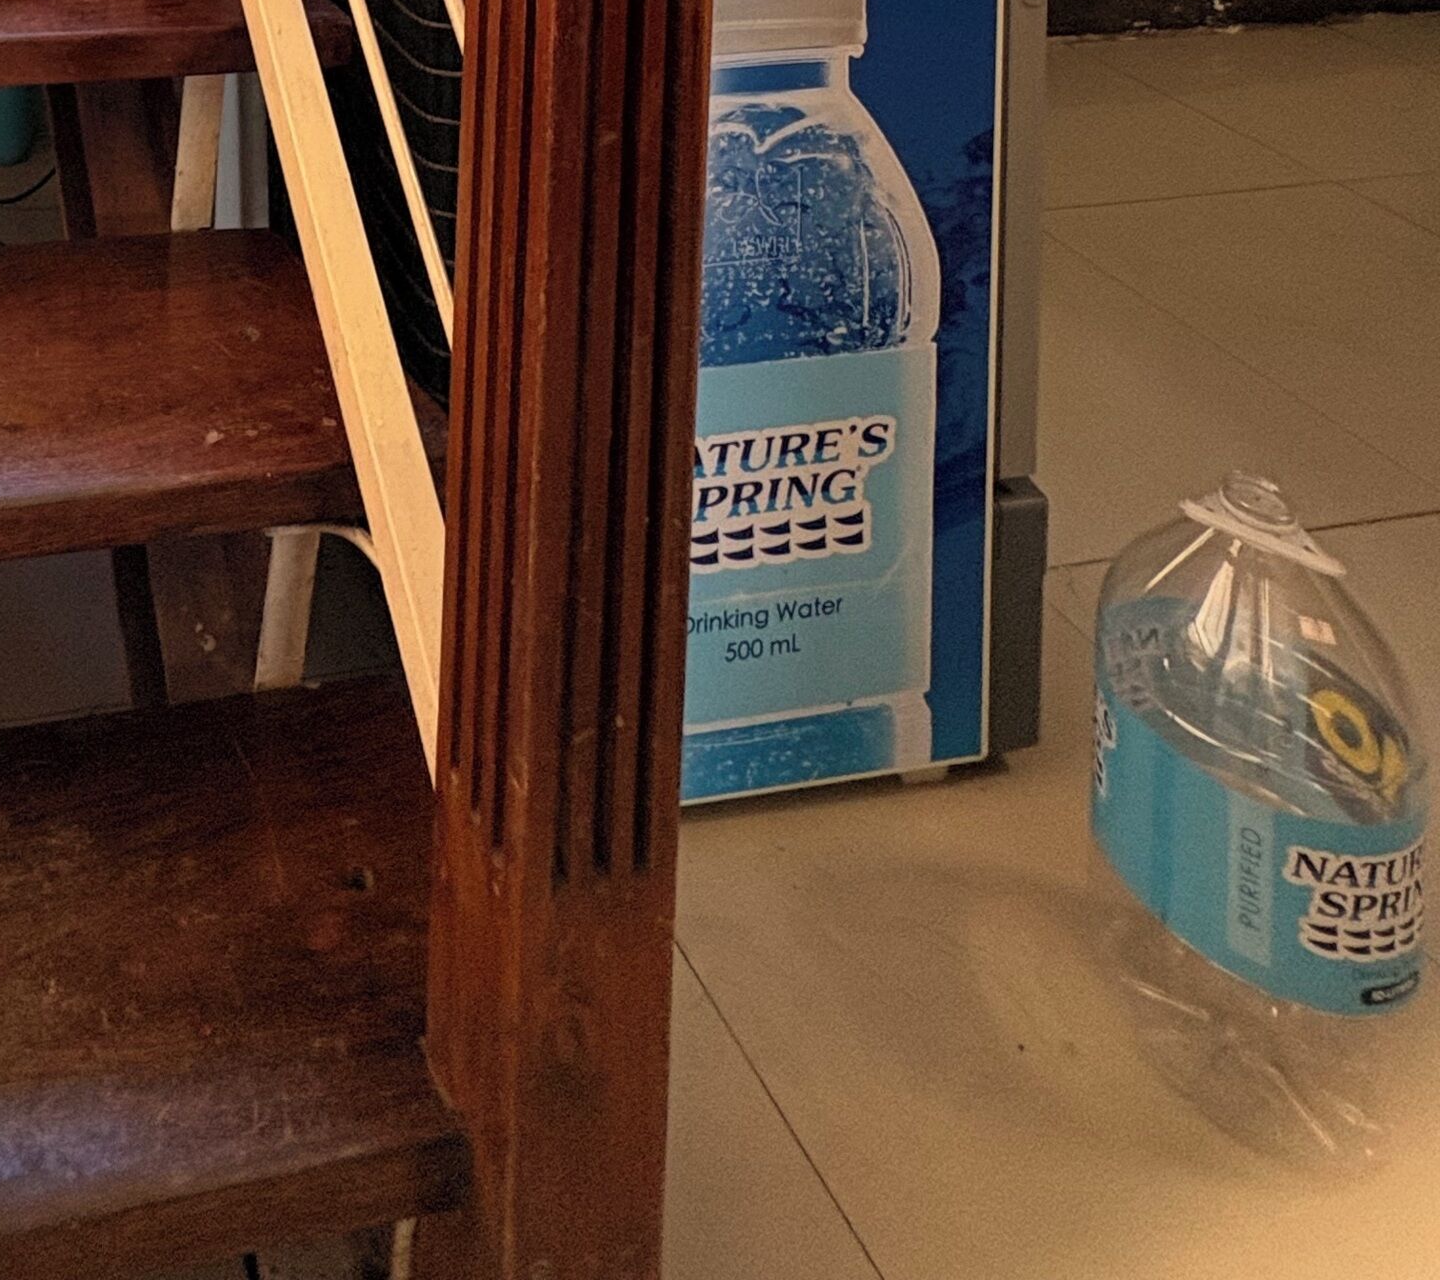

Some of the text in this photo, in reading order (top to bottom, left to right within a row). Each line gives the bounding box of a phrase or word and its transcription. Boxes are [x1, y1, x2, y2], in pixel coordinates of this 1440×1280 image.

[776, 596, 844, 621] Water
[724, 633, 802, 663] 500 mL
[1239, 827, 1261, 932] PURIFIED
